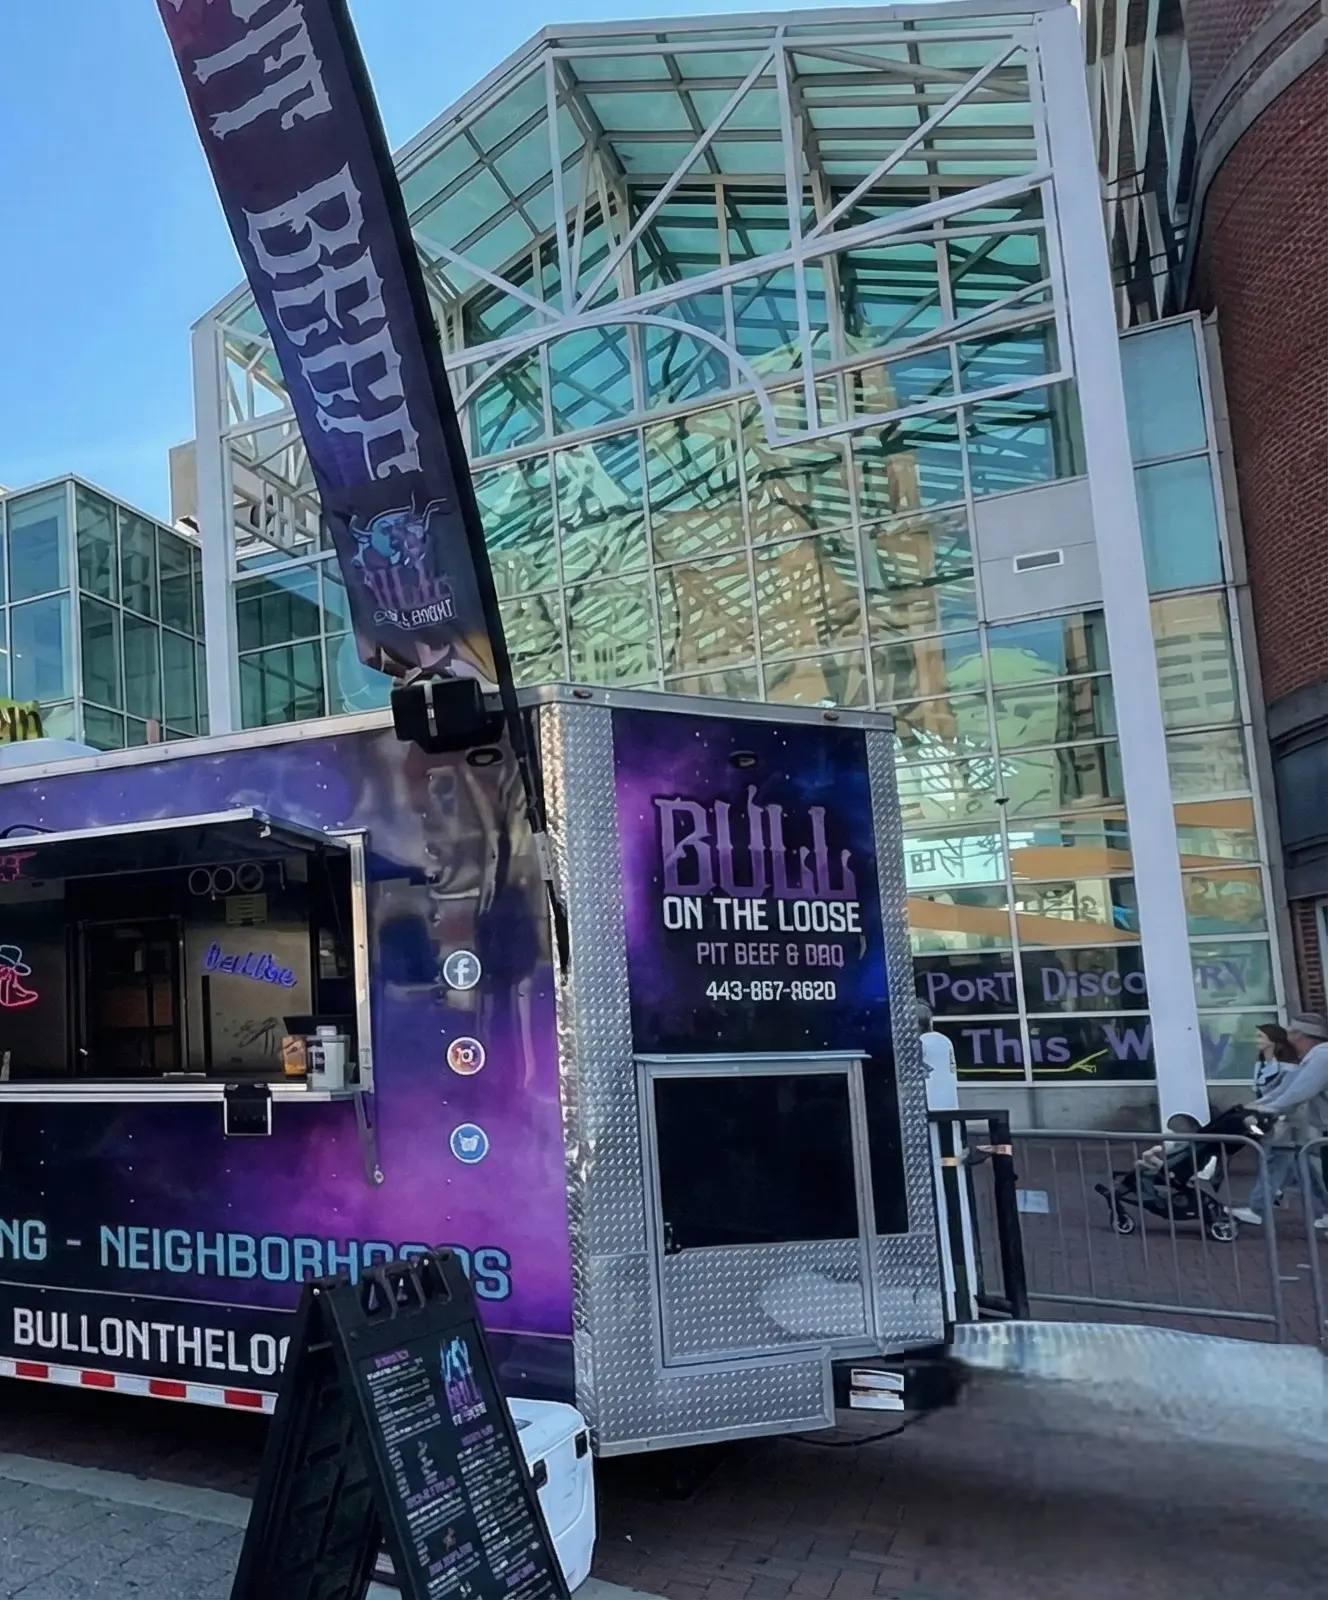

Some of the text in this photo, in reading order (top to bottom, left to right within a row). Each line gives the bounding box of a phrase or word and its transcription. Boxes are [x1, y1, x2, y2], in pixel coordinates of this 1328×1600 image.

[241, 162, 423, 481] BEEF
[654, 784, 857, 899] BULL
[663, 897, 862, 933] ON THE LOOSE
[697, 942, 728, 965] PIT
[734, 942, 780, 965] BEEF
[786, 943, 799, 966] &
[960, 1023, 1231, 1073] This Wy
